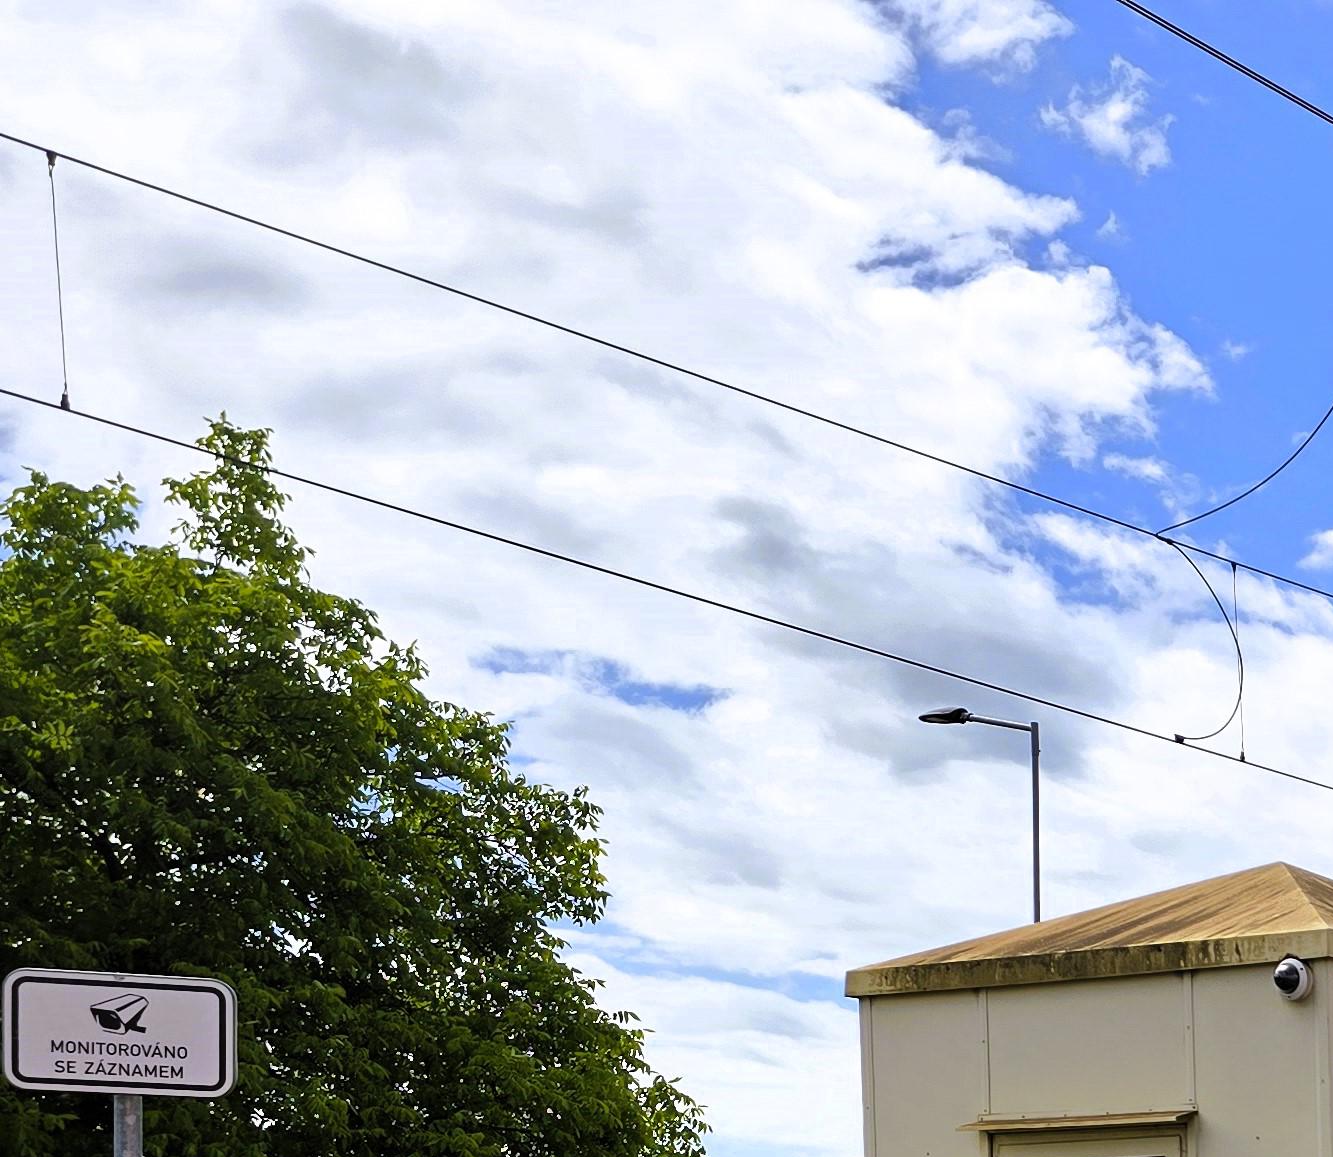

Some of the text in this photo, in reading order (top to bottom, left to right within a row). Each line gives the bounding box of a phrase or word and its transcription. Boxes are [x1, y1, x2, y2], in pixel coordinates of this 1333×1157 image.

[50, 1039, 188, 1060] MONITOROVÁNO
[54, 1058, 184, 1079] SE ZÁZNAMEM
